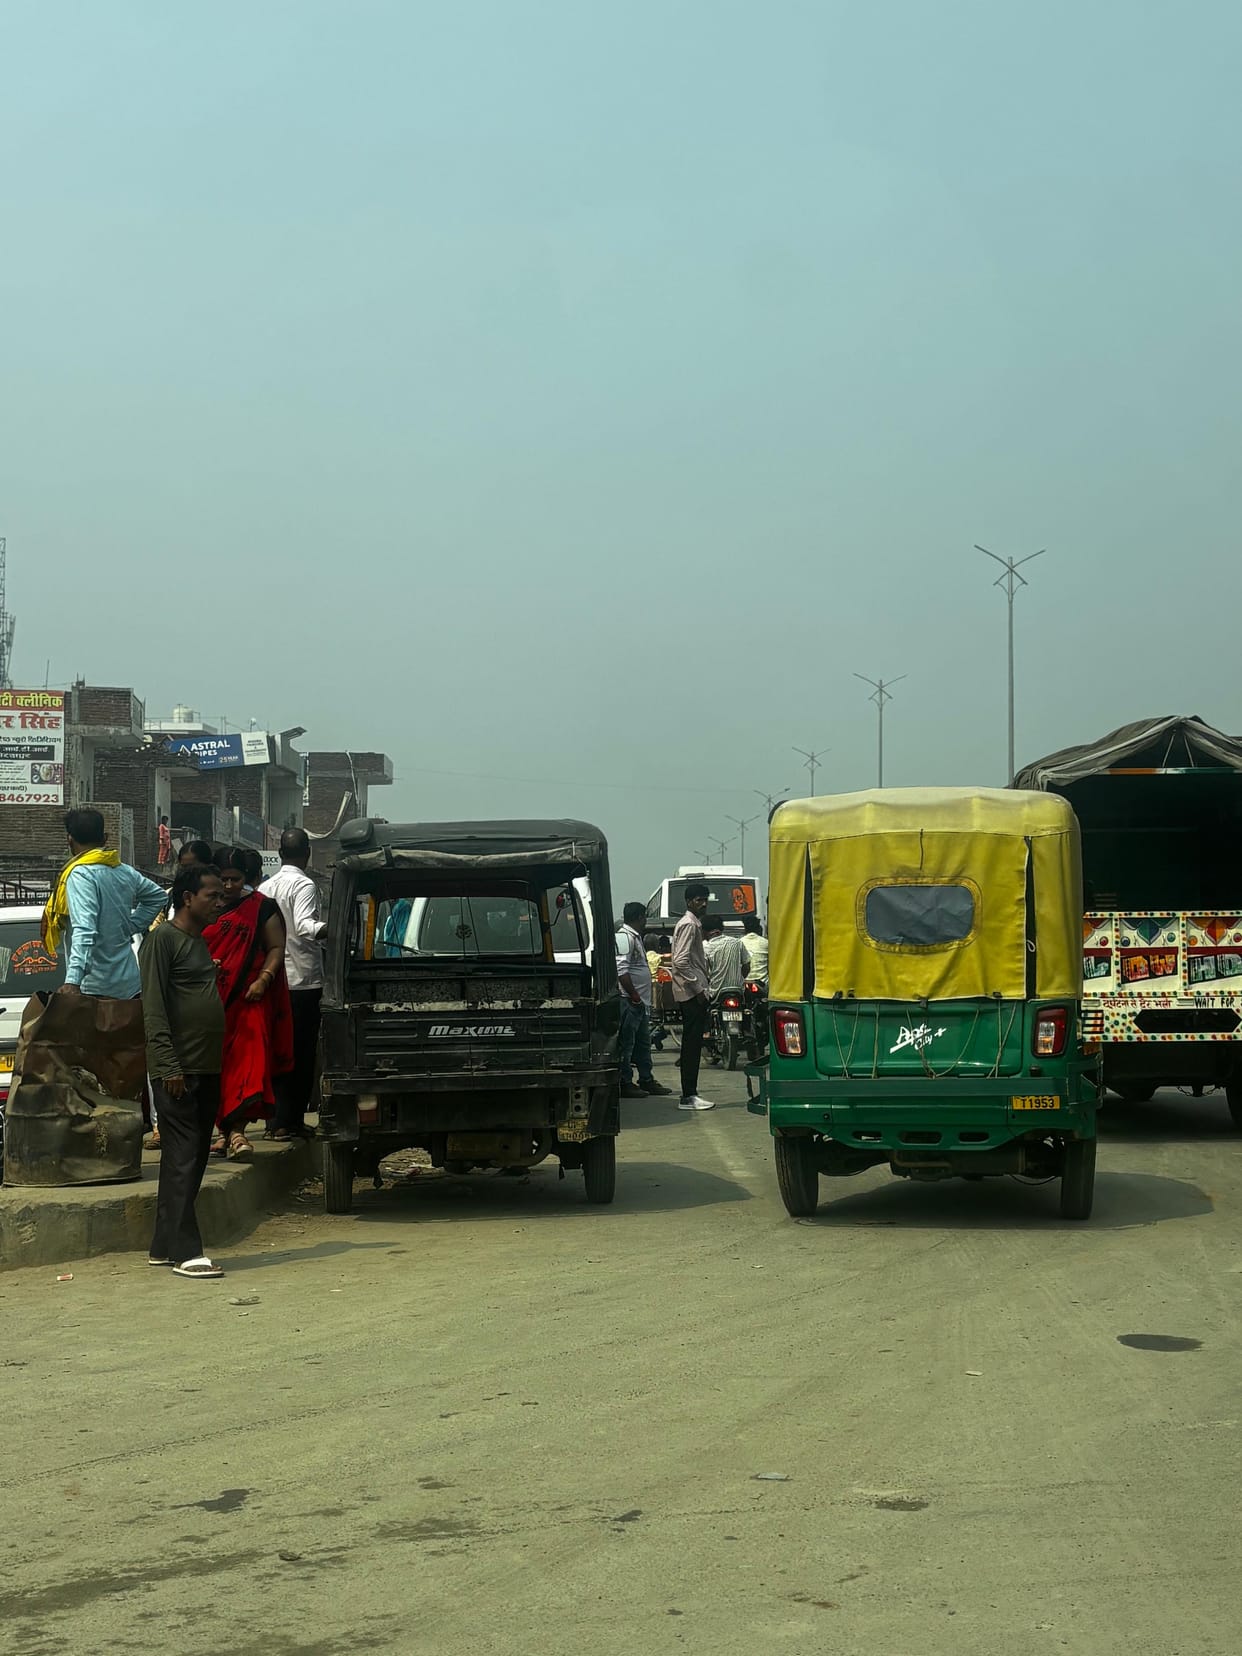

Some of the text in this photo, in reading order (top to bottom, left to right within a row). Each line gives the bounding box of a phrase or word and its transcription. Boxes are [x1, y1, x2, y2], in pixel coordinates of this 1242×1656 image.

[190, 739, 231, 752] ASTRAL
[1194, 997, 1216, 1009] WAIT
[1220, 997, 1235, 1008] FOR
[1021, 1098, 1055, 1108] T1953
